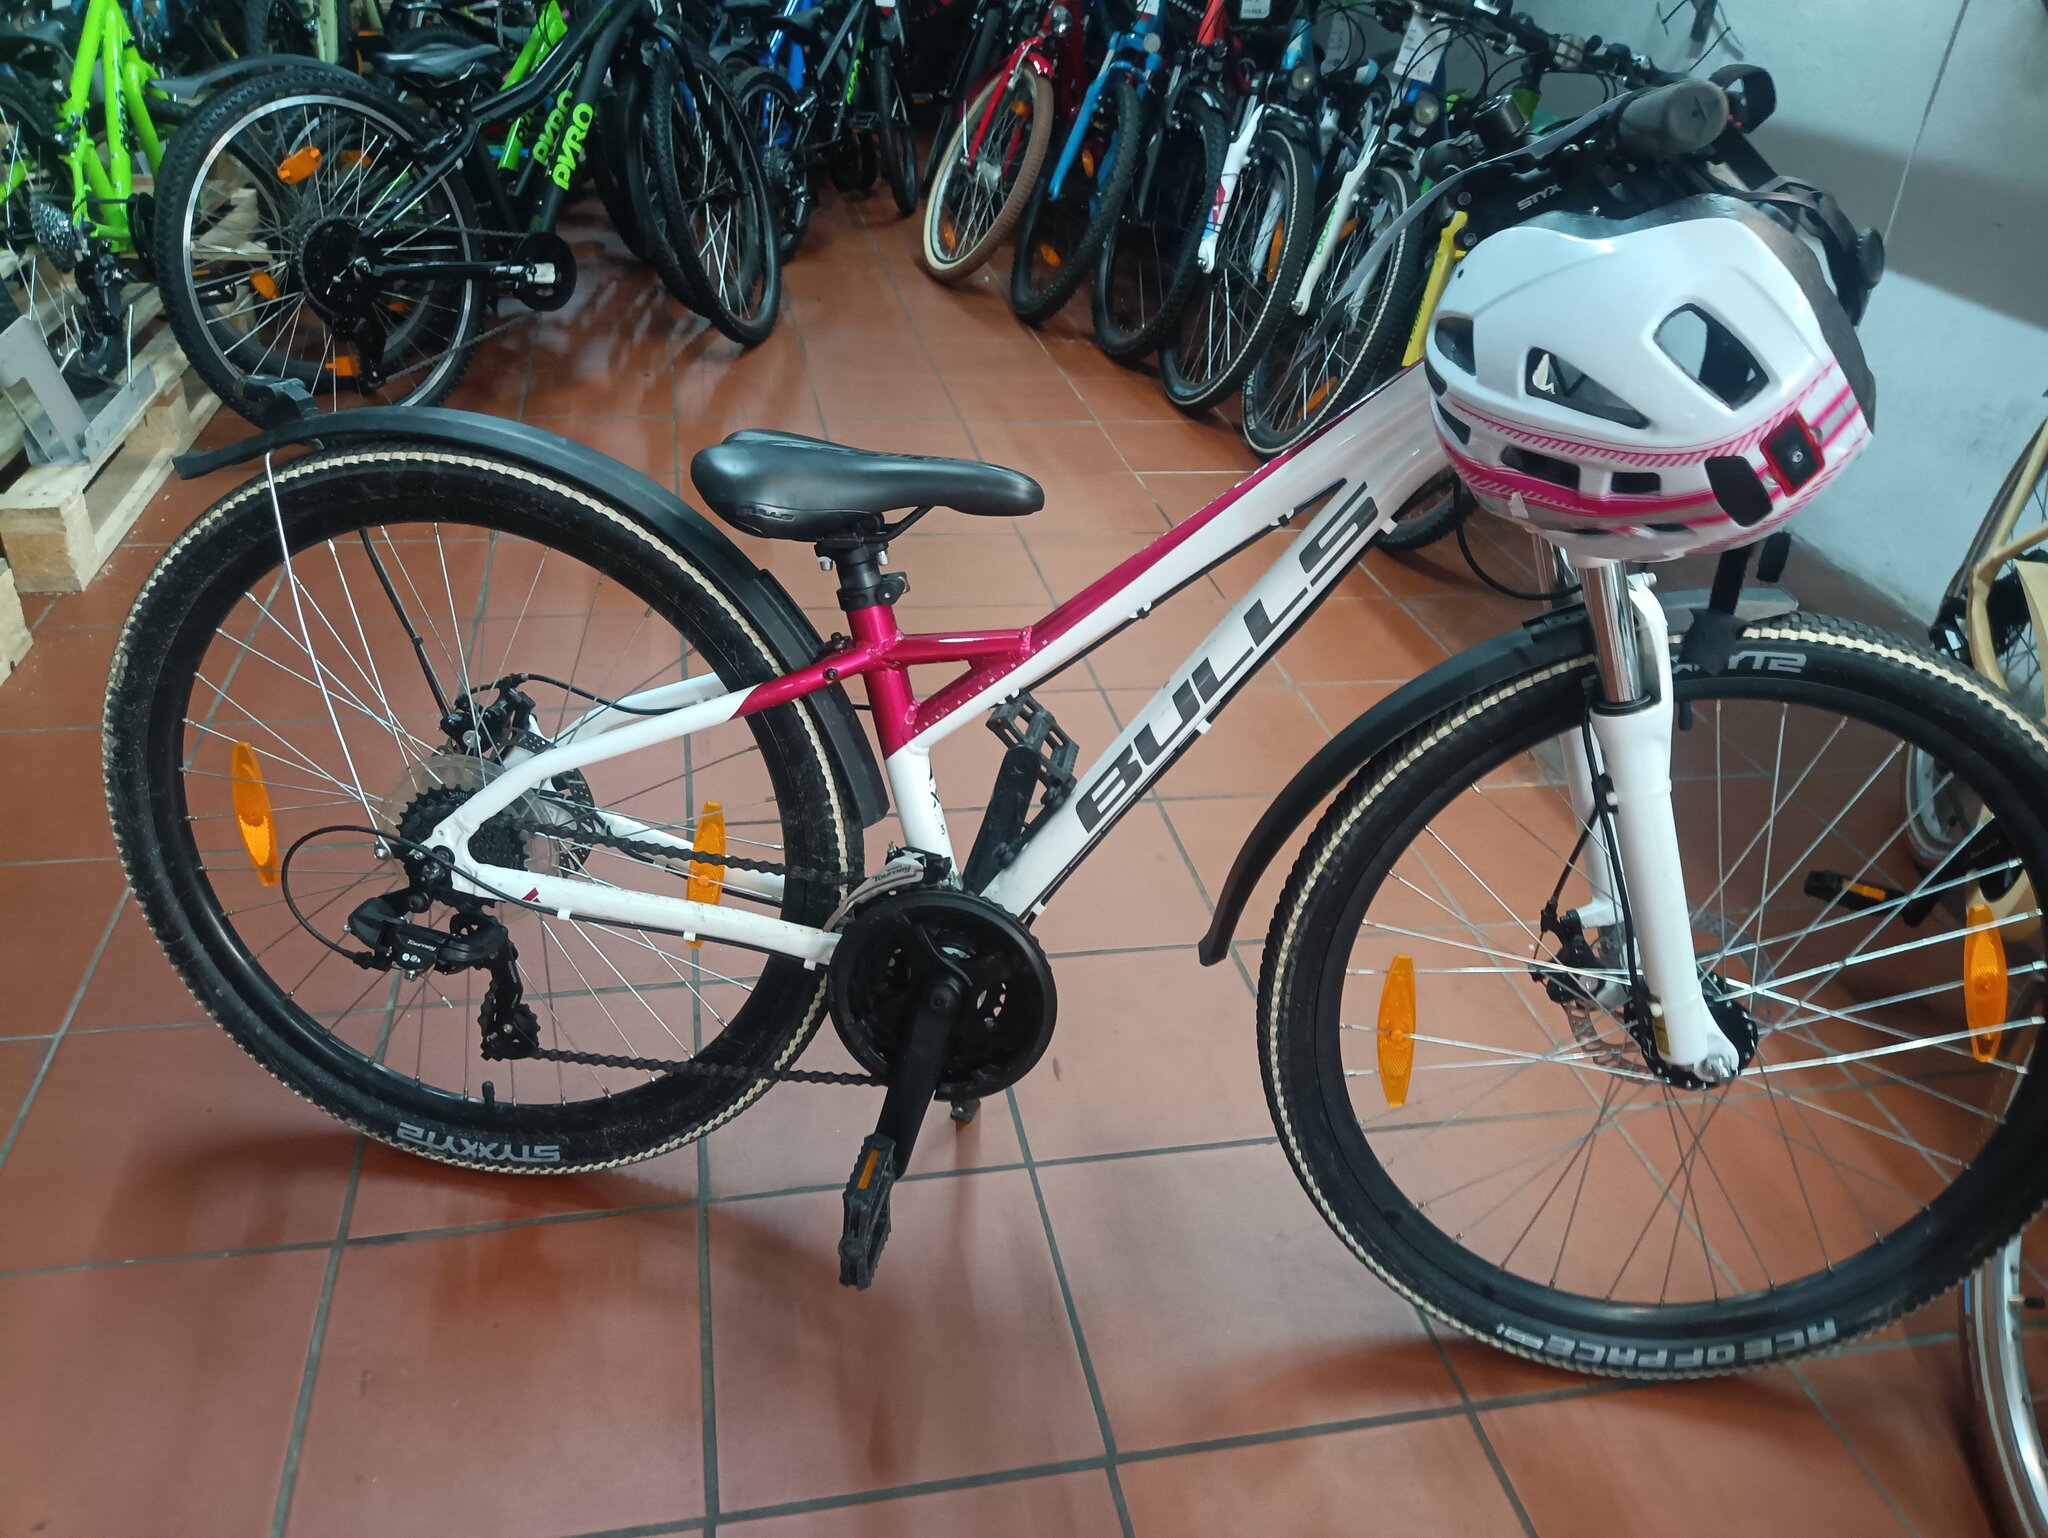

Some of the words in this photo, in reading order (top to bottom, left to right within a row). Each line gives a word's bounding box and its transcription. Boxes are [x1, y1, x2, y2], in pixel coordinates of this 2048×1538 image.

[552, 102, 594, 191] PYRO
[1516, 184, 1563, 211] STYX
[957, 639, 1049, 705] ALUMINIUM
[1075, 480, 1379, 835] BULLS
[1545, 1335, 1668, 1369] PACE
[1673, 1344, 1736, 1369] OF
[1743, 1317, 1837, 1361] ACE
